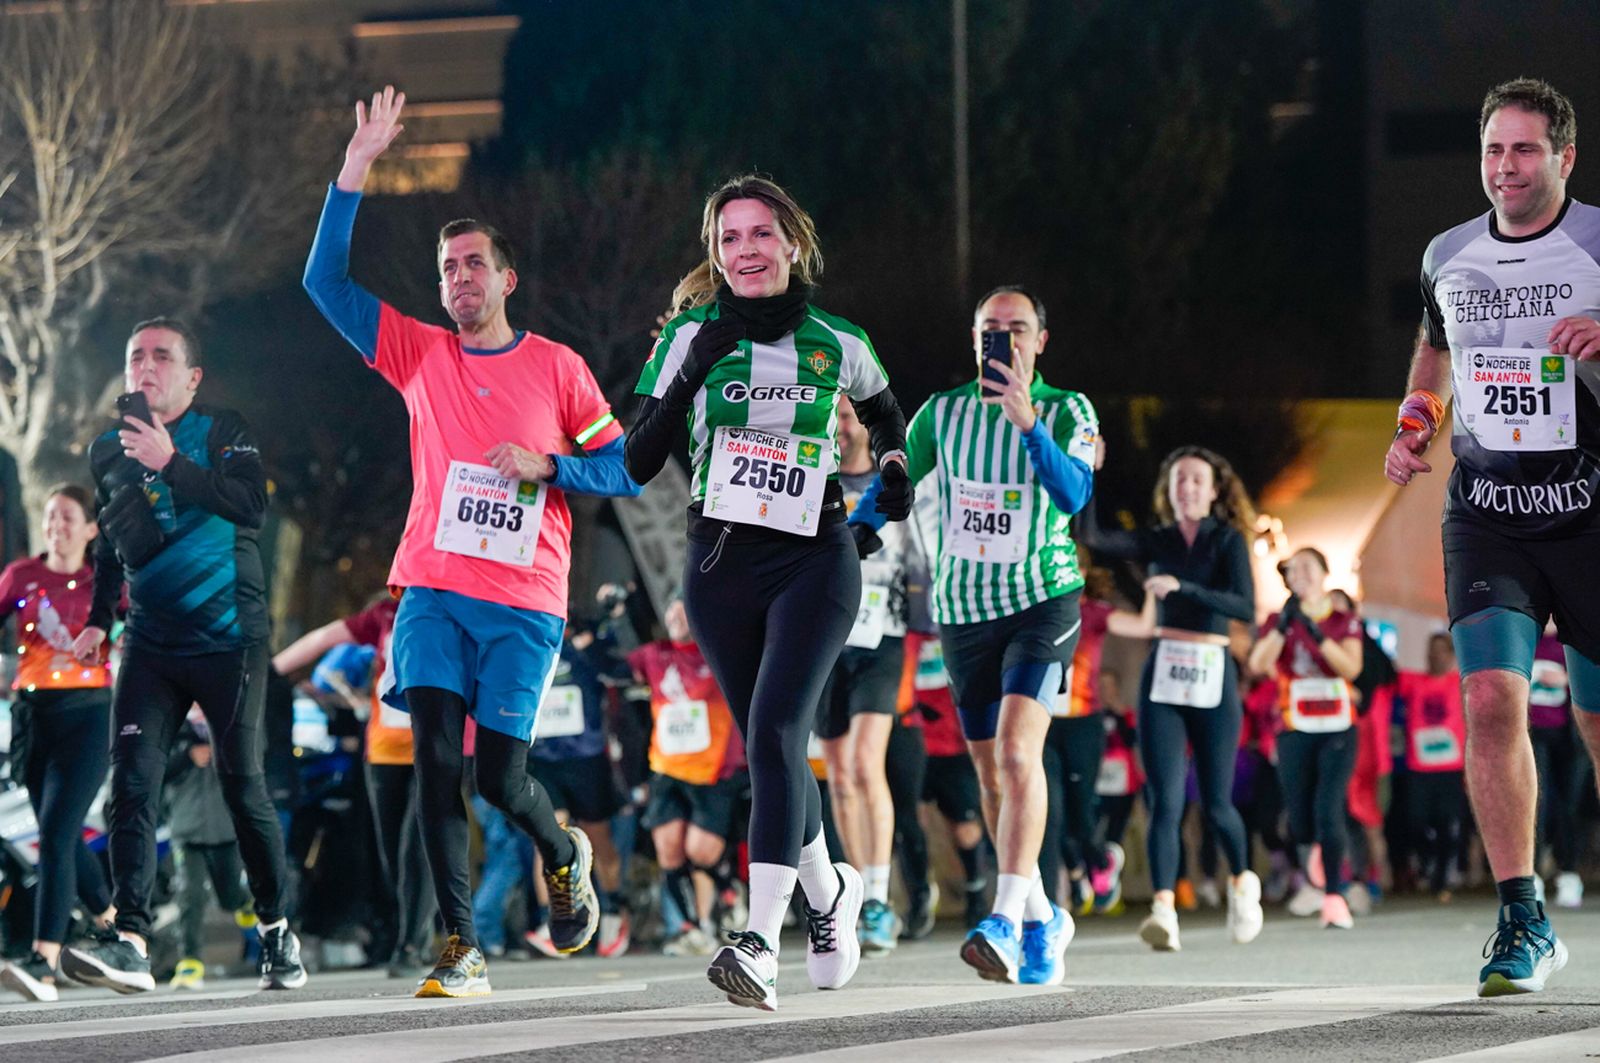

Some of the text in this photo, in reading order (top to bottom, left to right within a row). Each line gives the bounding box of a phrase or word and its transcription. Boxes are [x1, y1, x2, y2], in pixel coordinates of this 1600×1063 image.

[1447, 283, 1573, 308] ULTRAFONDO
[1455, 300, 1556, 323] CHICLANA
[1486, 359, 1531, 370] NOCHE DE
[1474, 371, 1494, 383] SAN
[1495, 369, 1531, 384] ANTÓN
[750, 386, 816, 402] GREE
[1483, 384, 1551, 416] 2551
[1503, 417, 1529, 425] Antonio
[741, 430, 773, 447] NOCHE
[775, 438, 789, 450] DE
[726, 441, 750, 454] SAN
[750, 445, 787, 462] ANTÓN
[470, 474, 496, 486] NOCHE
[729, 455, 806, 497] 2550
[456, 484, 475, 495] SAN
[476, 487, 509, 501] ANTÓN
[756, 491, 773, 501] Rosa
[1467, 477, 1591, 515] NOCTURNIS
[457, 496, 524, 532] 6853
[963, 508, 1011, 535] 2549
